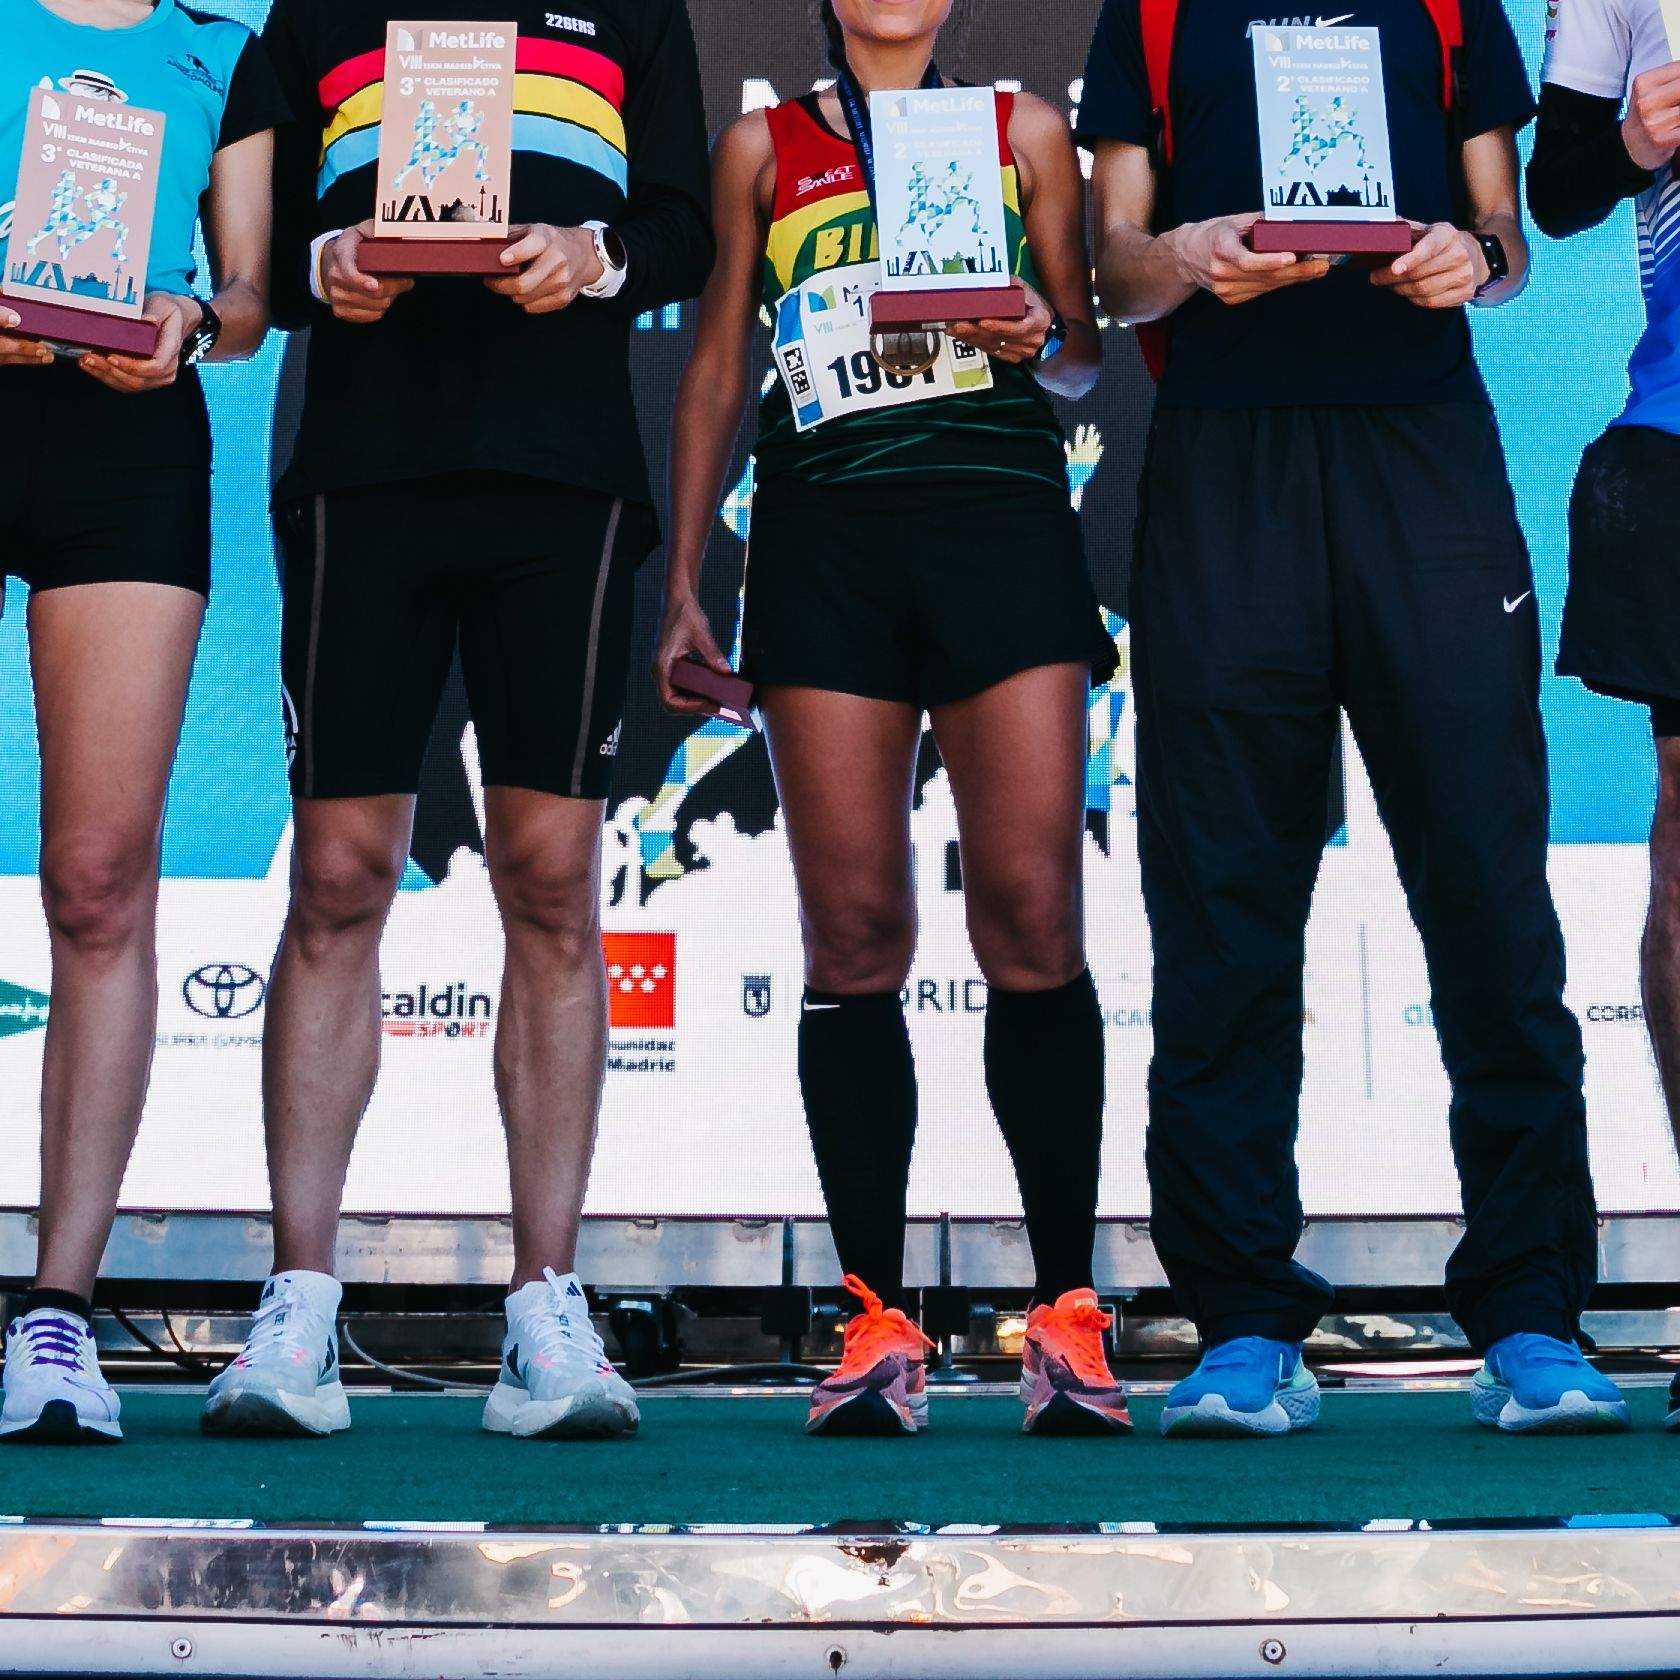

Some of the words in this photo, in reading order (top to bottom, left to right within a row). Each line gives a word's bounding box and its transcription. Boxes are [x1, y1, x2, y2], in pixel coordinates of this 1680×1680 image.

[544, 12, 596, 37] 226ERS
[428, 31, 506, 50] MetLife
[1295, 34, 1371, 51] MetLife
[398, 54, 423, 70] VIII
[423, 77, 500, 87] CLASIFICADO
[426, 87, 486, 97] VETERANO
[487, 88, 497, 97] A
[74, 104, 156, 137] MetLife
[42, 121, 68, 140] VIII
[66, 148, 144, 172] CLASIFICADA
